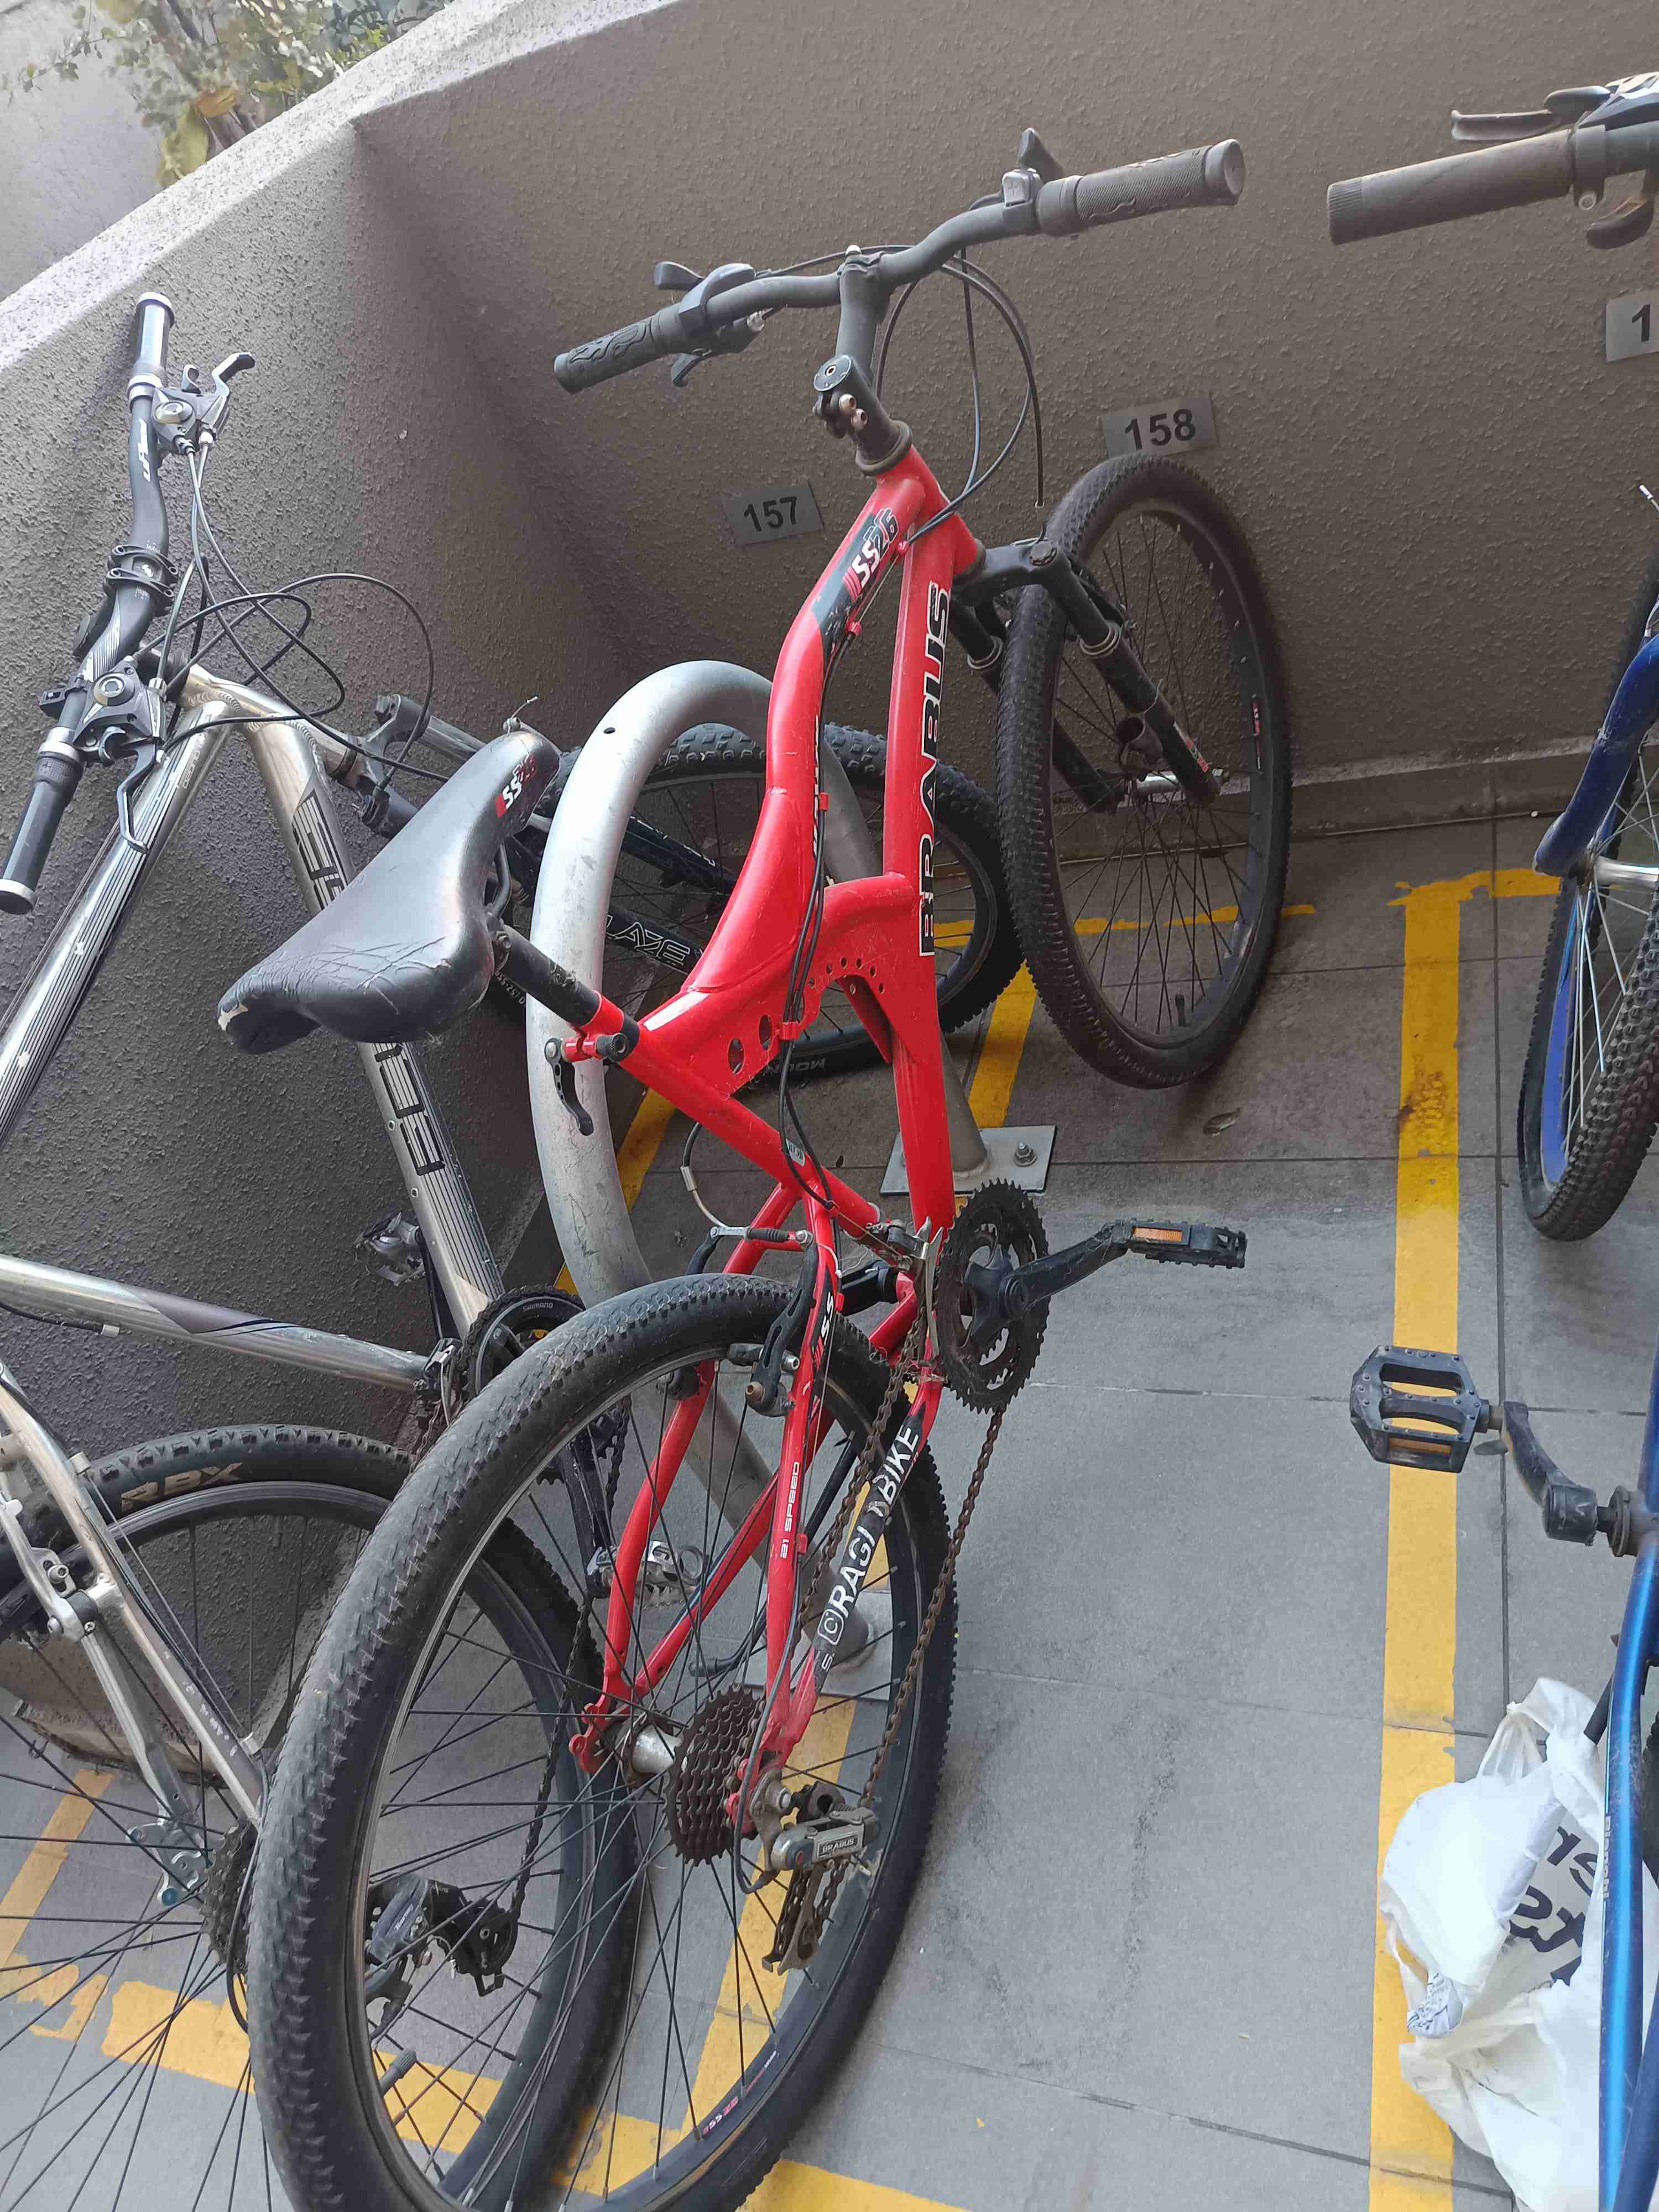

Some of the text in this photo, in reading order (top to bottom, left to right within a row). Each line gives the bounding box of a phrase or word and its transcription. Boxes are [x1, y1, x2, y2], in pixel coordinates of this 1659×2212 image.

[1124, 409, 1196, 450] 158
[744, 496, 797, 532] 157
[919, 581, 951, 956] BRABUS
[607, 915, 691, 966] LAZE
[872, 1424, 919, 1505] BIKE
[780, 1462, 800, 1558] 21 SPEED
[822, 1839, 854, 1853] BRABUS
